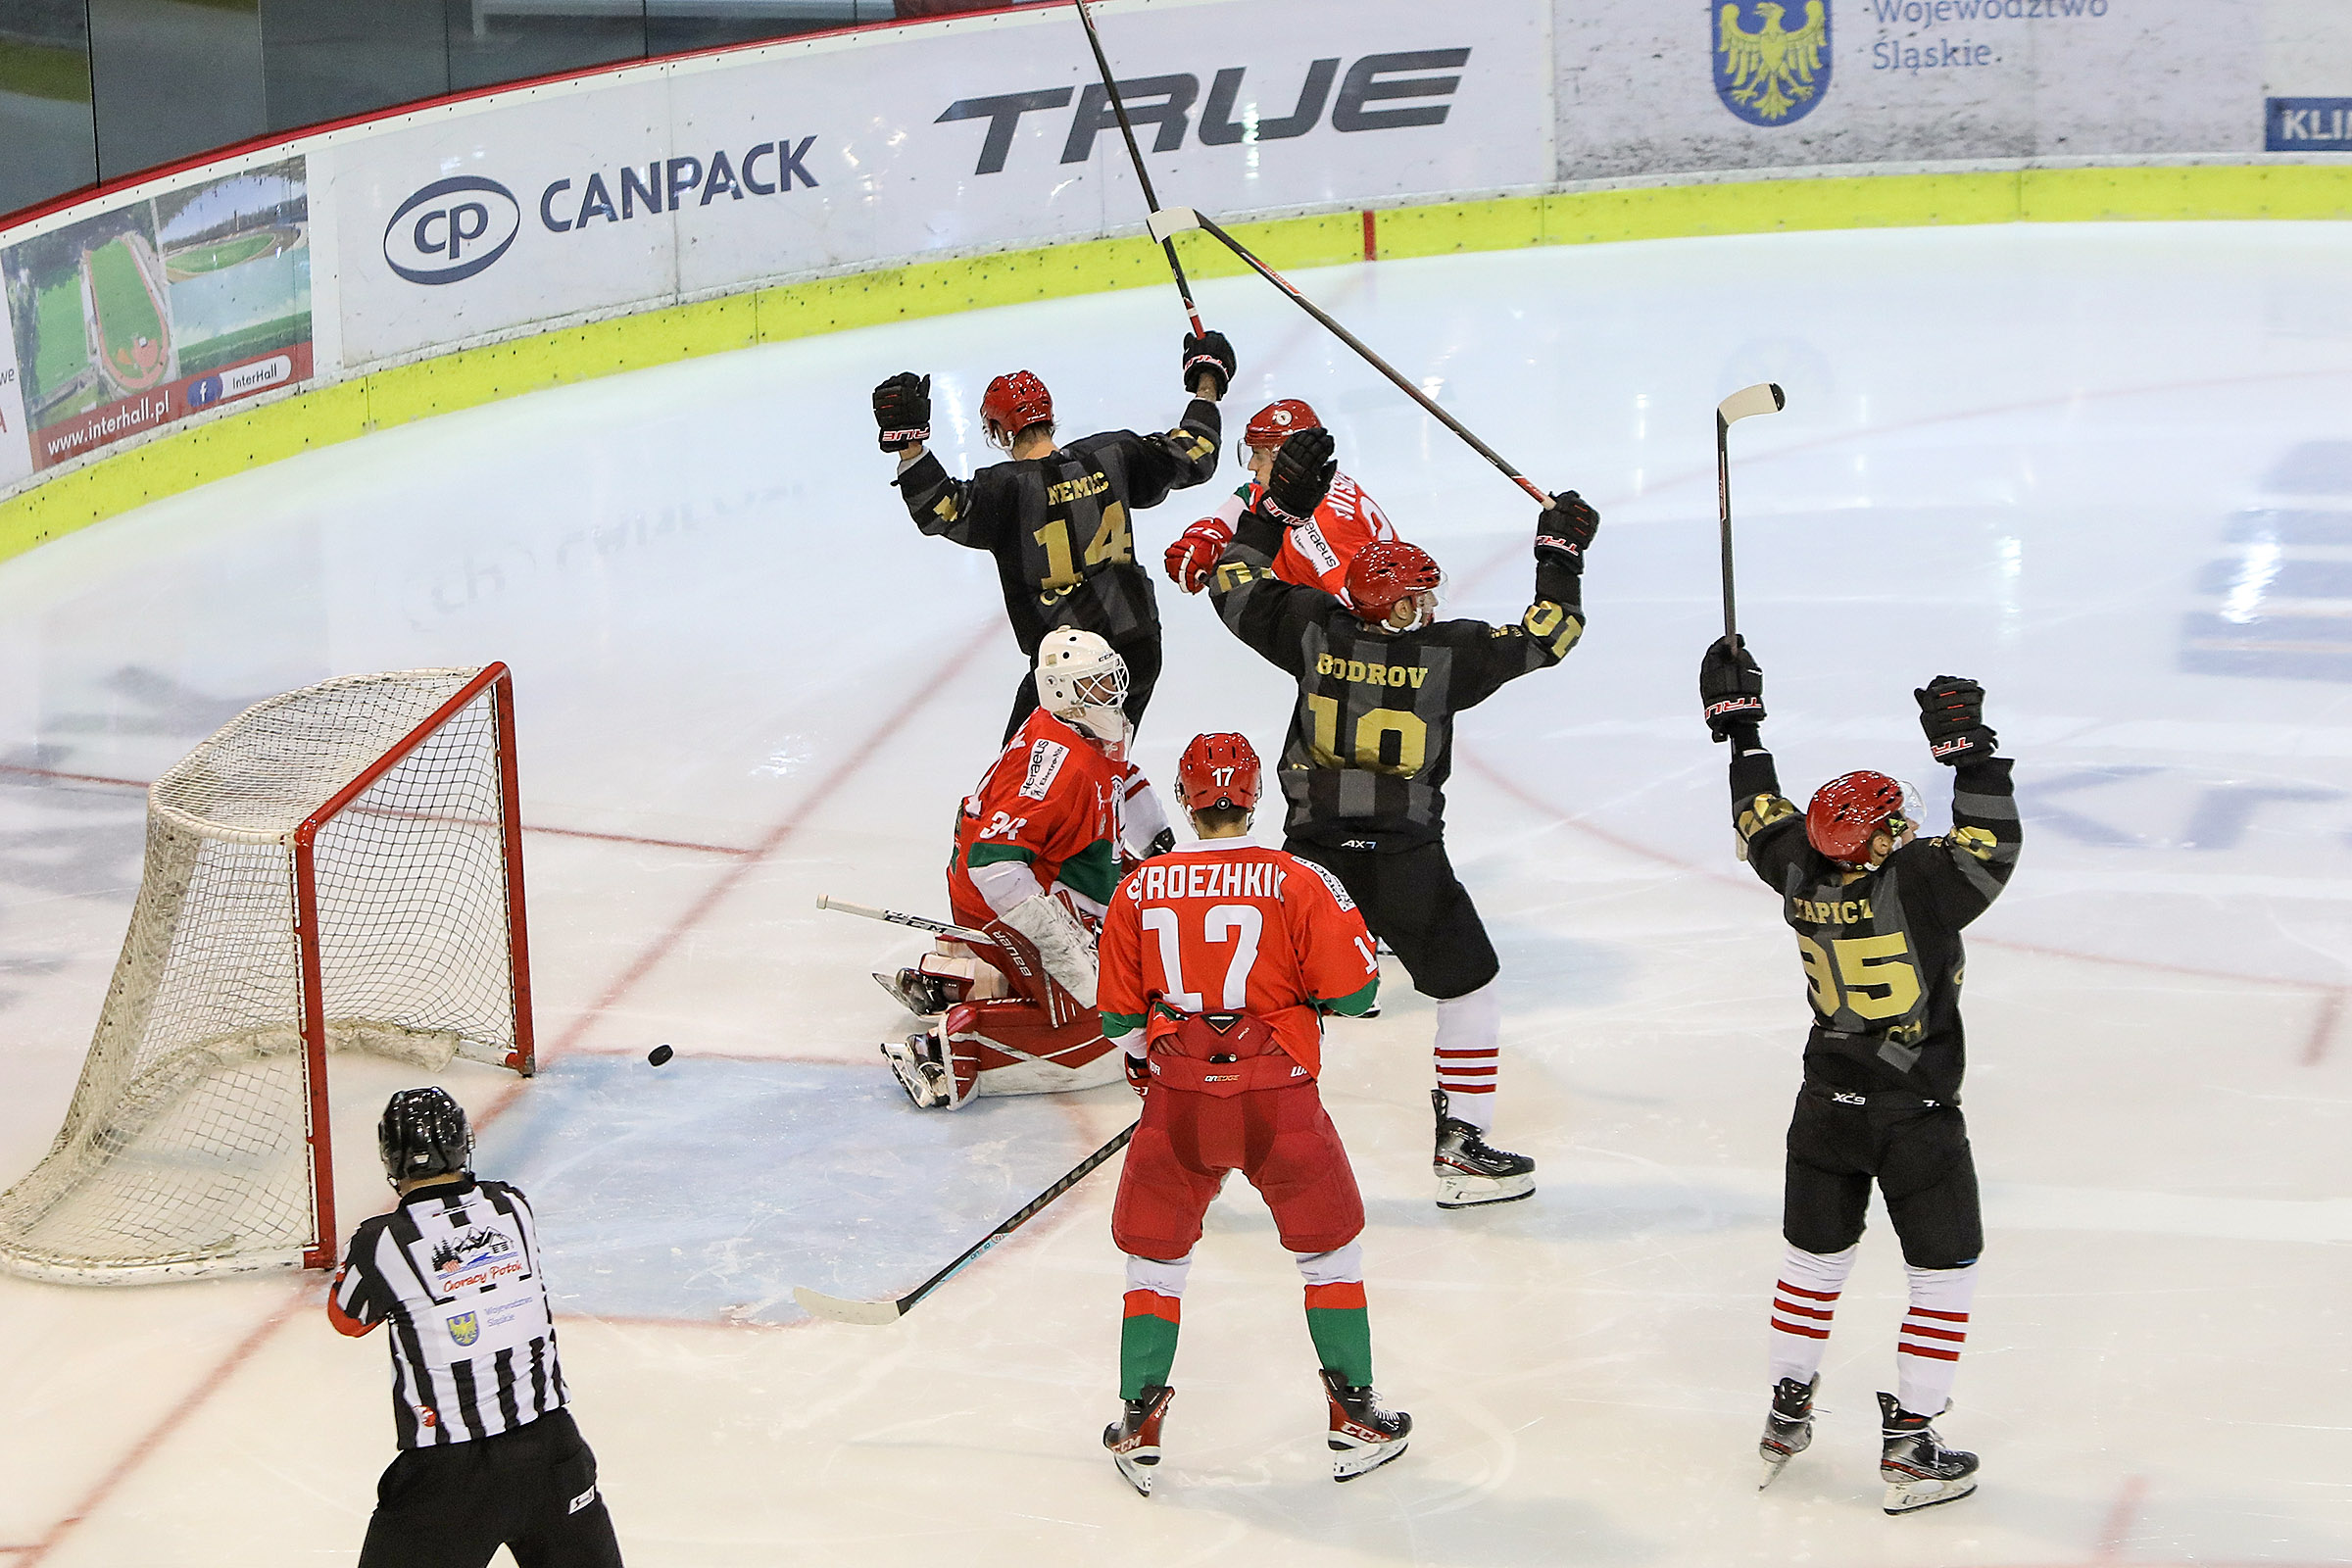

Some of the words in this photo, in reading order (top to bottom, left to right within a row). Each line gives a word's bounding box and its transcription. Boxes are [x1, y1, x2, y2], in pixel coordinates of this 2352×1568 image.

[934, 47, 1472, 175] TRUE
[2282, 109, 2352, 140] KLI
[540, 134, 818, 232] CANPACK
[232, 363, 277, 390] InterHall
[47, 390, 171, 456] www.interhall.pl
[1033, 500, 1132, 590] 14
[1303, 520, 1338, 568] eraeus
[1316, 653, 1429, 689] BODROV
[1308, 692, 1428, 780] 10
[1020, 740, 1050, 797] Heraeus
[1211, 768, 1235, 787] 17
[980, 810, 1027, 841] 34
[1142, 904, 1263, 1013] 17
[1339, 1421, 1391, 1444] CCM
